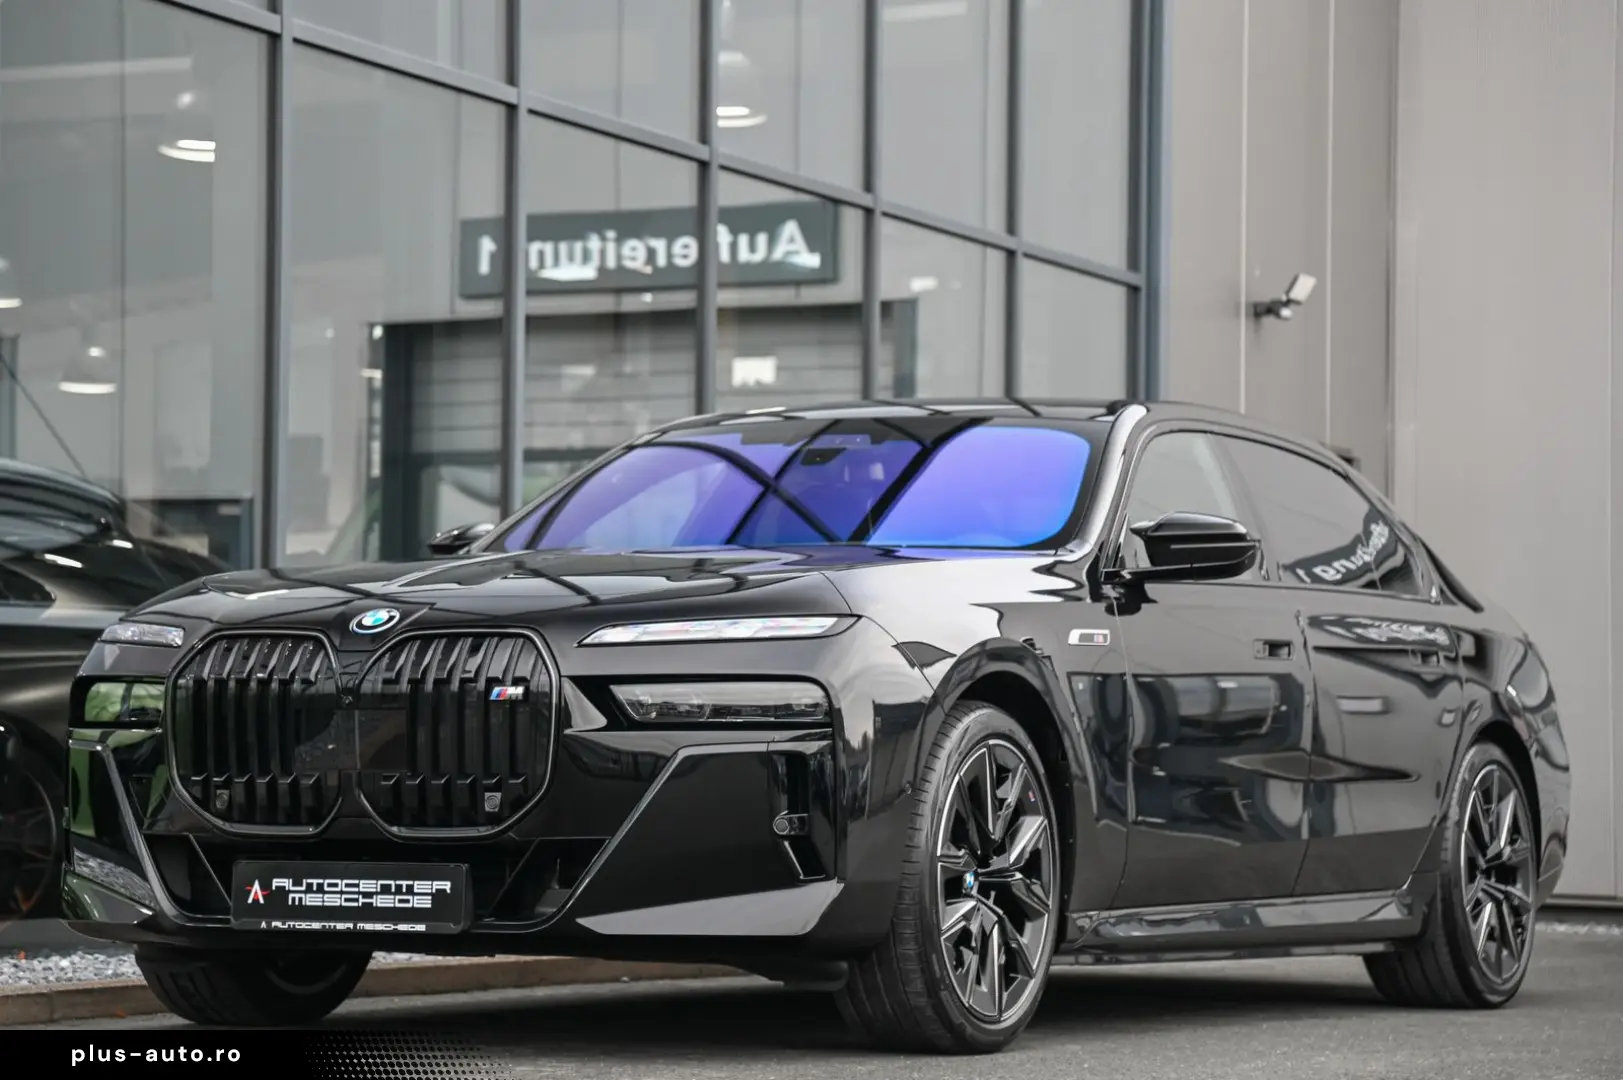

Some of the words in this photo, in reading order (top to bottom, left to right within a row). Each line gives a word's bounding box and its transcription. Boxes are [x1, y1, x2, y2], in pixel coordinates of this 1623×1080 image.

[272, 878, 452, 894] AUTOCENTER
[288, 893, 433, 909] MESCHEDE
[271, 921, 354, 930] AUTOCENTER
[356, 923, 427, 932] MESCHEDE
